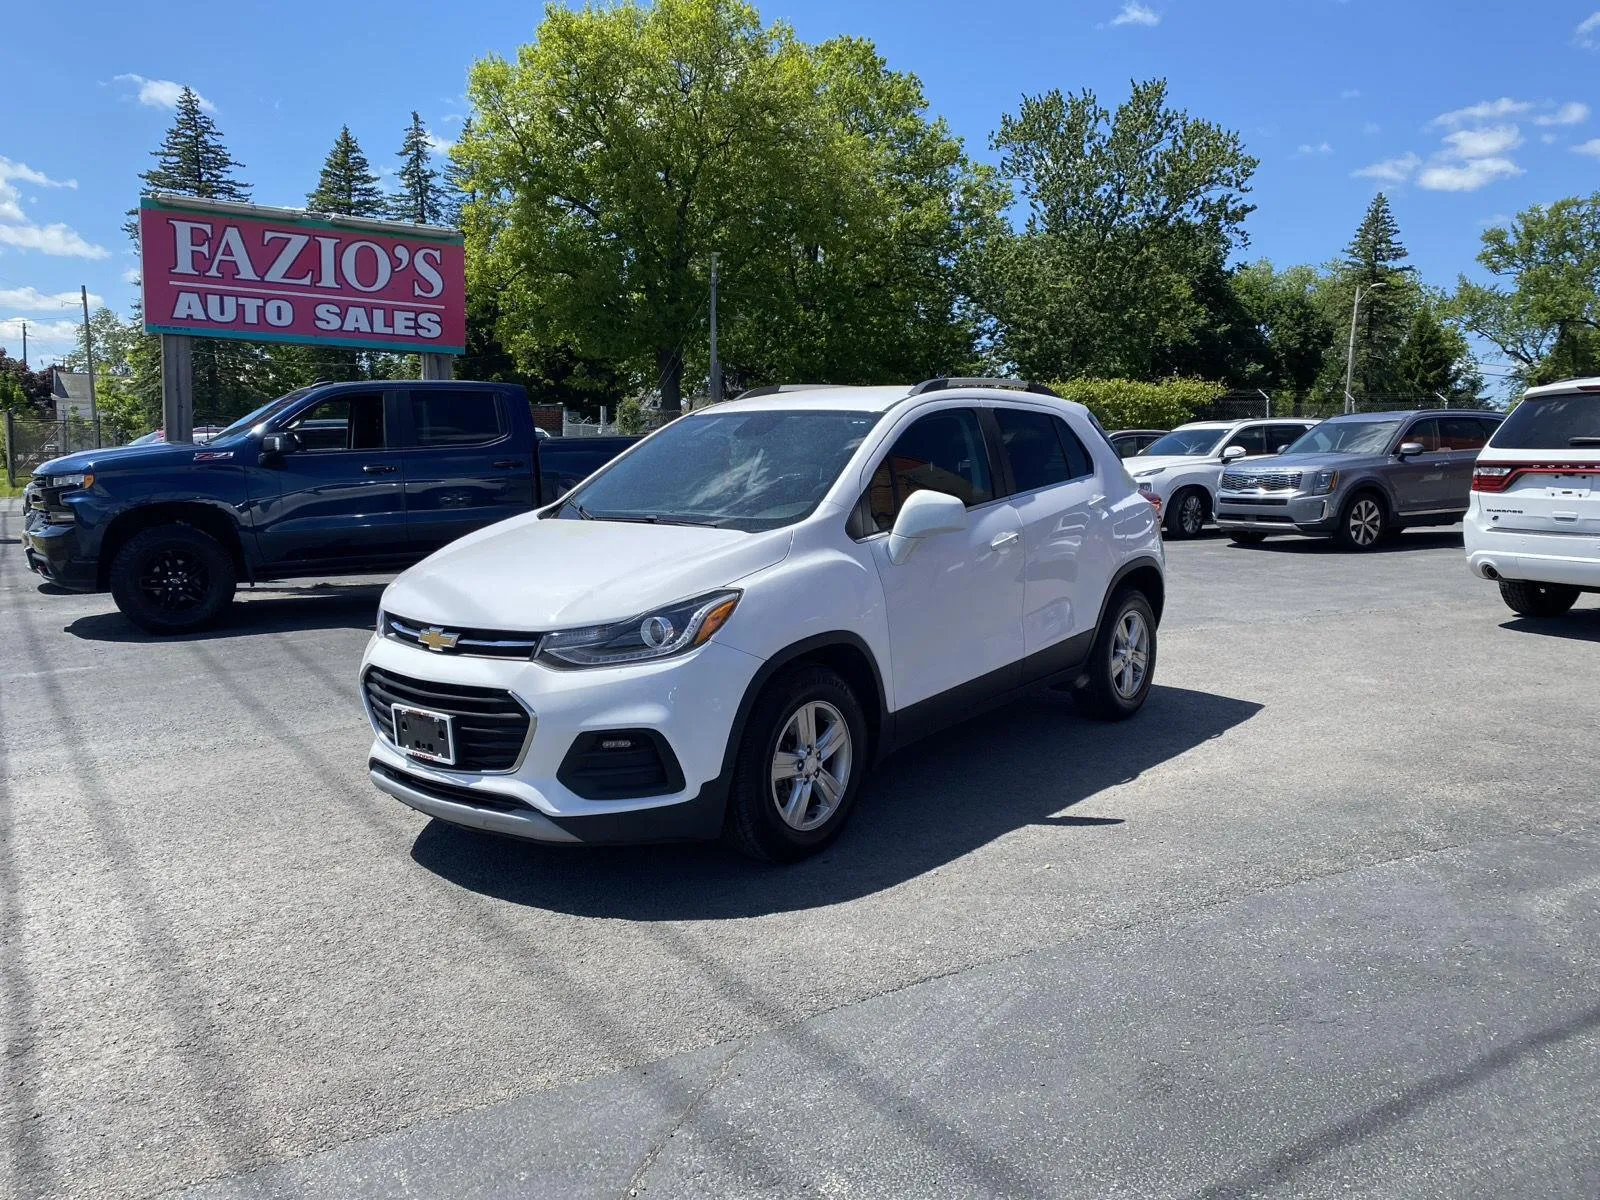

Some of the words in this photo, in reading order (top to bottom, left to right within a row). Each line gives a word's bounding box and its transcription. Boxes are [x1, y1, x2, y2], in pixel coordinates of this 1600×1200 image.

[167, 218, 445, 298] FAZIO'S
[172, 291, 294, 327] AUTO
[314, 303, 442, 339] SALES
